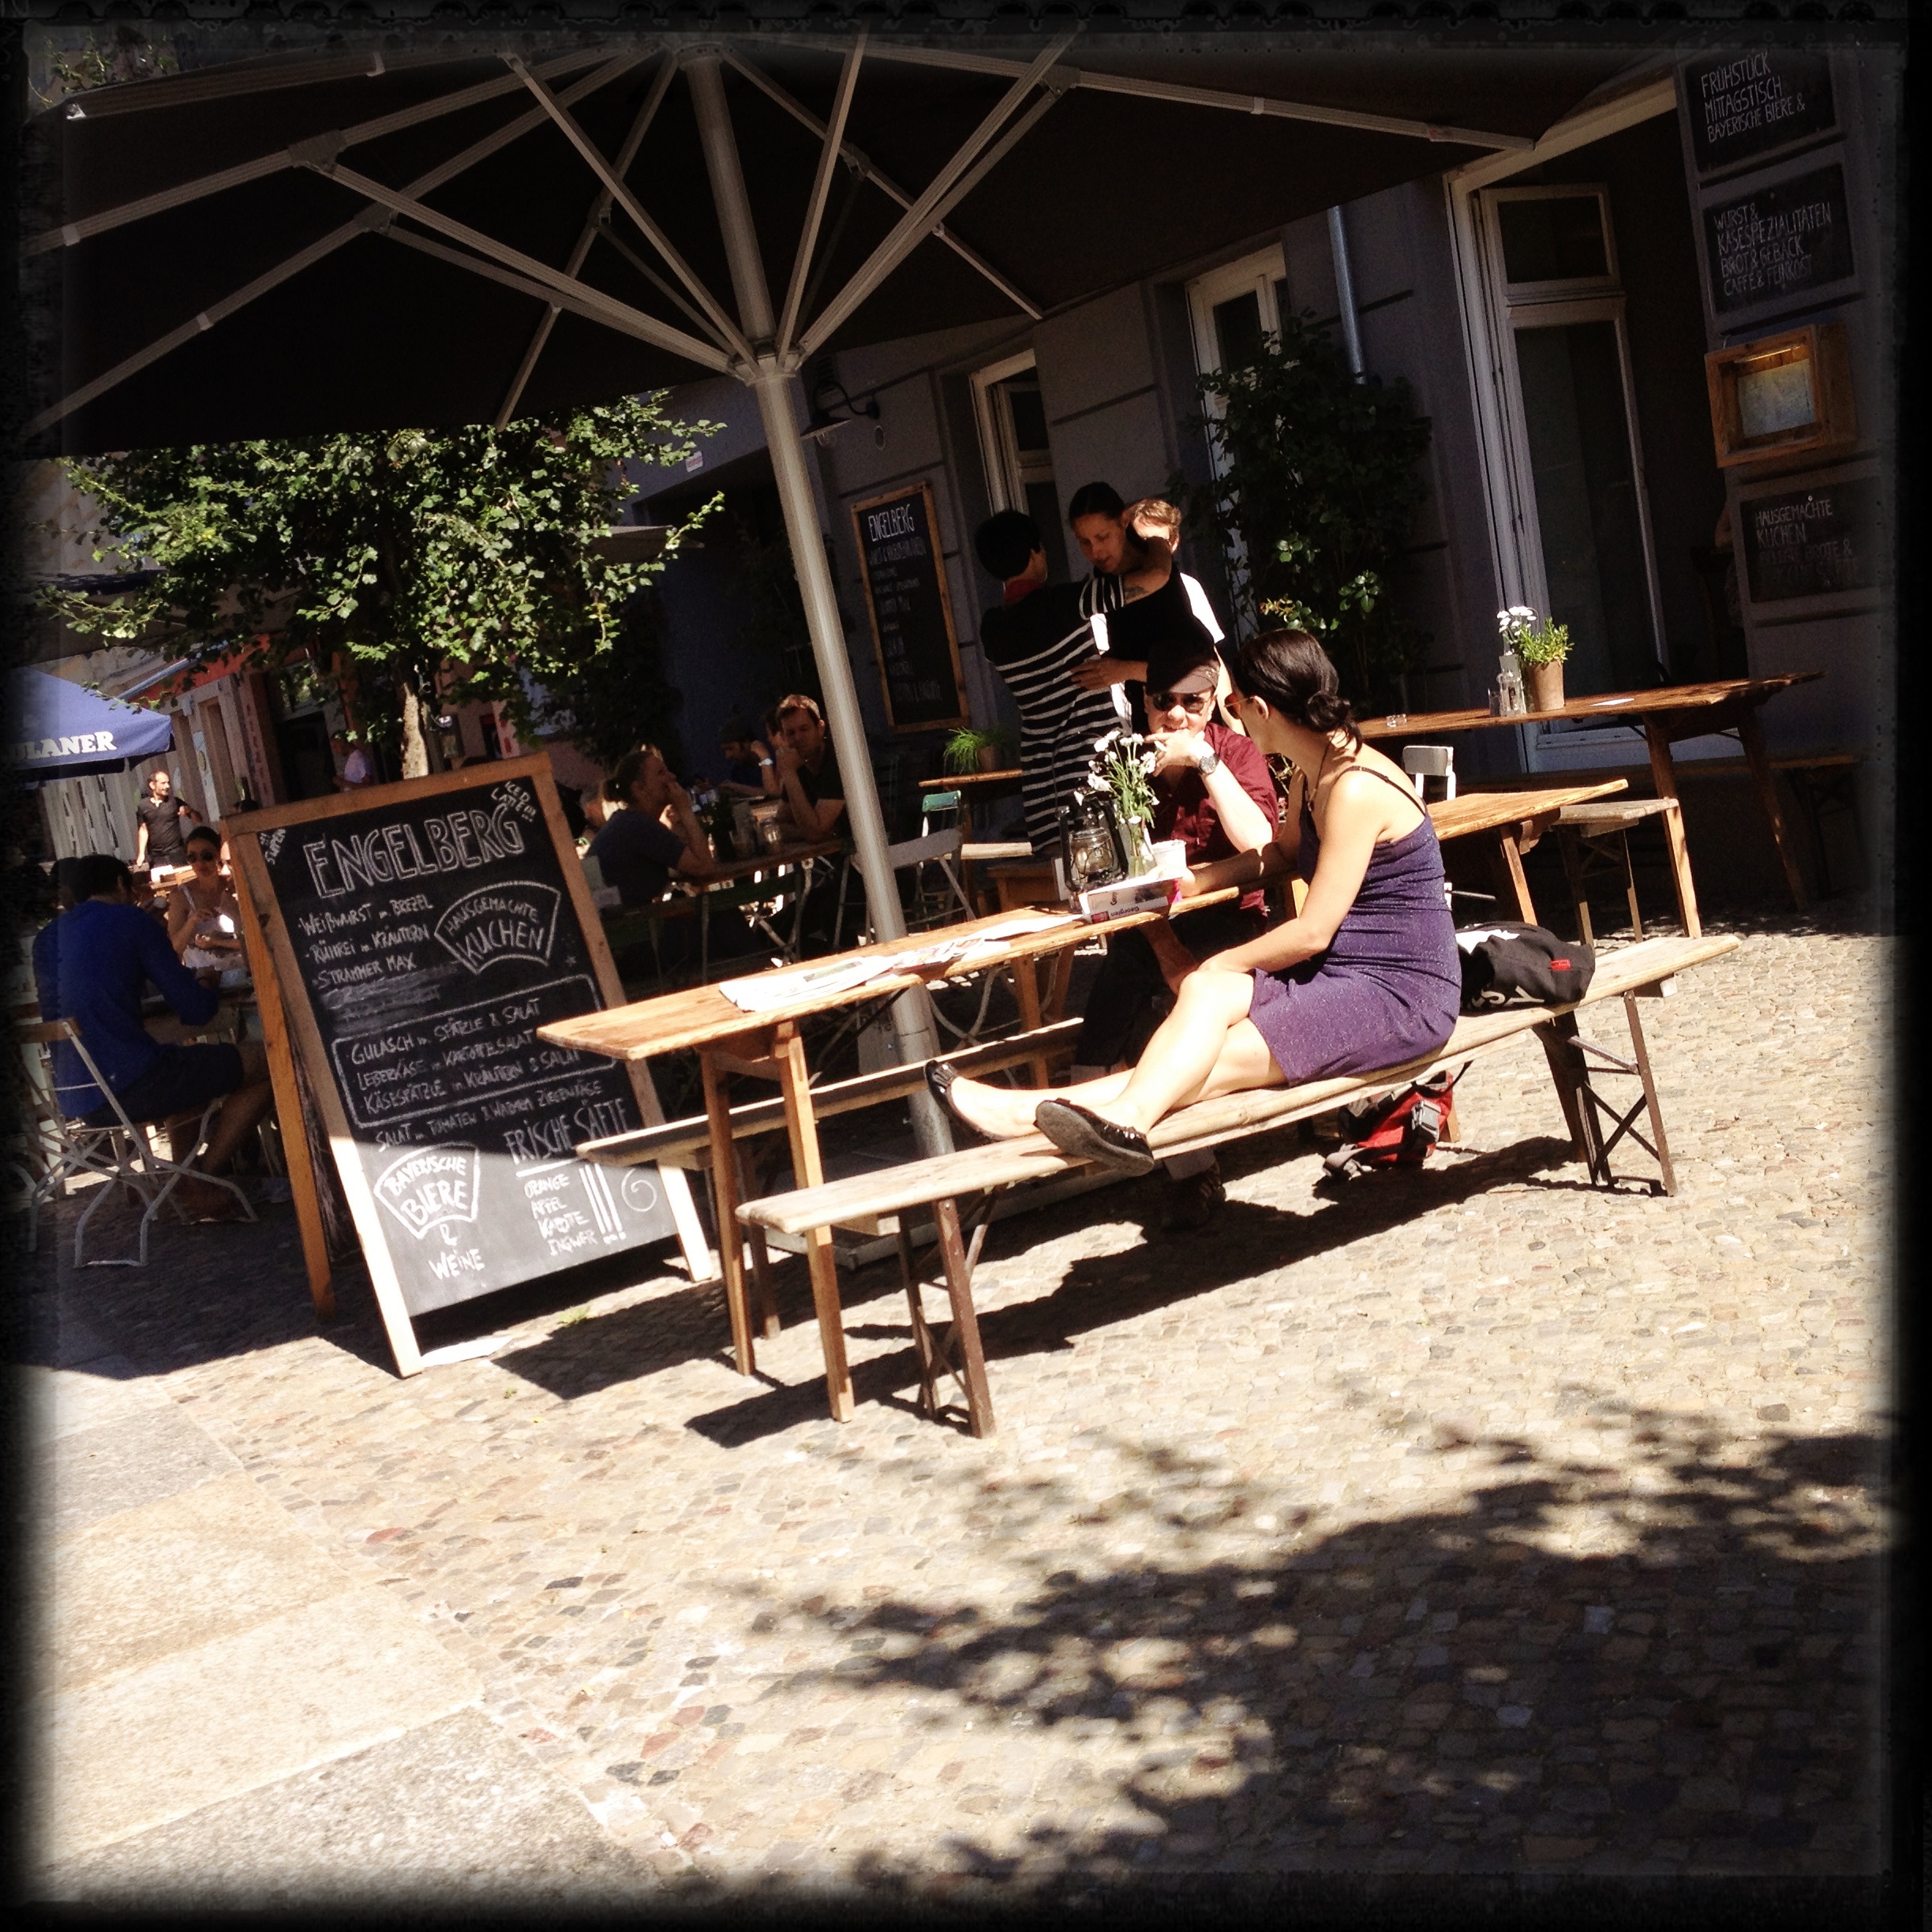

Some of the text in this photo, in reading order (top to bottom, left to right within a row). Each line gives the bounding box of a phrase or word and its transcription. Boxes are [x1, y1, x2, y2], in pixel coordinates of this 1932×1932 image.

[1701, 51, 1772, 99] FRÜHSTÜCK
[1707, 92, 1807, 144] BAYERISCHE BIERE &
[1713, 205, 1748, 230] WURST
[867, 504, 915, 542] ENGELBERG
[1754, 499, 1833, 528] HAUSGEMACHTE
[1756, 522, 1807, 549] KUCHEN
[302, 803, 525, 899] ENGELBERG
[444, 897, 540, 937] HAUSGEMACHTE
[456, 918, 545, 968] KUCHEN
[317, 952, 417, 990] STRAMMER MAX
[351, 1033, 415, 1065] GULASCH
[433, 1017, 485, 1043] SPÄTZLE
[502, 997, 540, 1025] SALAT
[357, 1058, 427, 1091] LEBERKÄSE
[363, 1079, 448, 1115] KÄSESPÄTZLE
[376, 1122, 412, 1153] SALAT
[427, 1111, 477, 1137] TOMATEN
[384, 1155, 467, 1196] BAYERISCHE
[524, 1174, 570, 1198] ORANGE
[399, 1179, 469, 1226] BIERE
[530, 1196, 567, 1219] APFEL
[439, 1223, 459, 1246] &
[548, 1228, 597, 1256] INGWER
